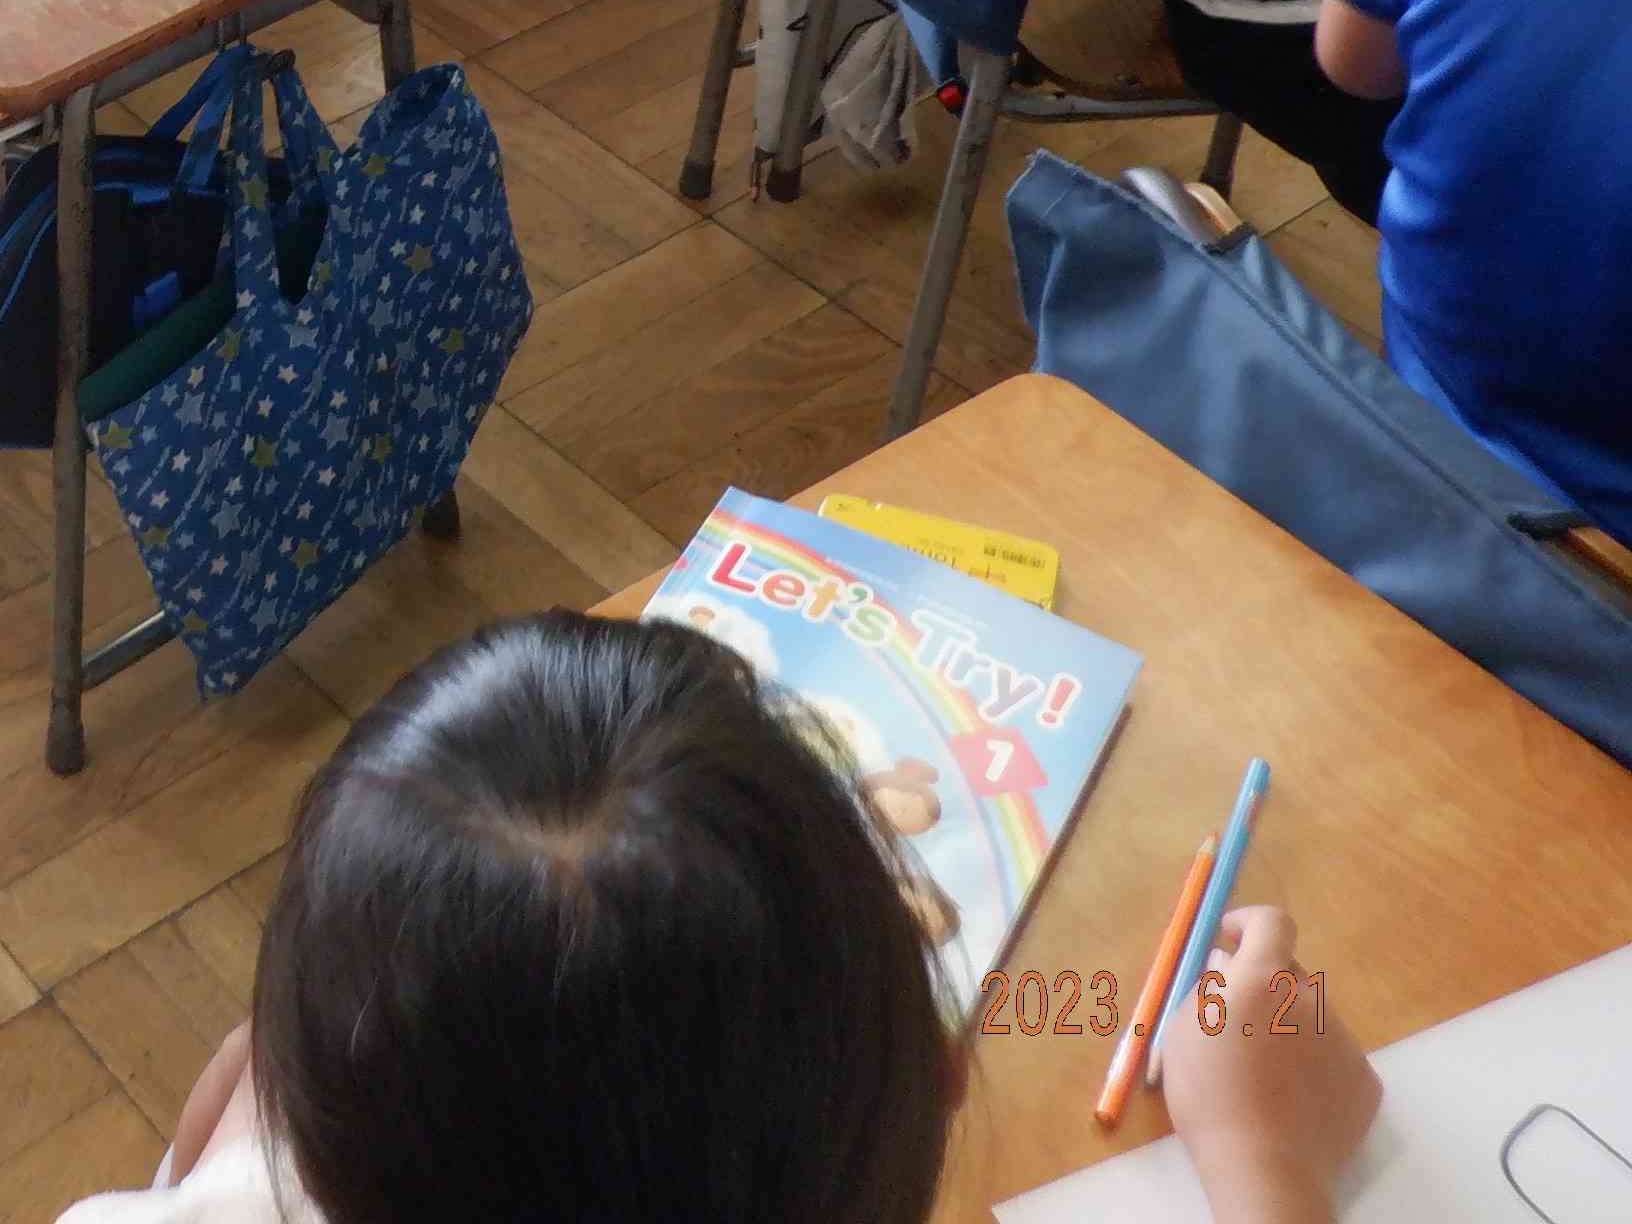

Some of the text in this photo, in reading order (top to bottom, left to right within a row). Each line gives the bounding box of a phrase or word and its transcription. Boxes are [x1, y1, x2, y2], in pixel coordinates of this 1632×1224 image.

[710, 541, 1079, 727] Let's Try!
[984, 739, 1016, 782] 1
